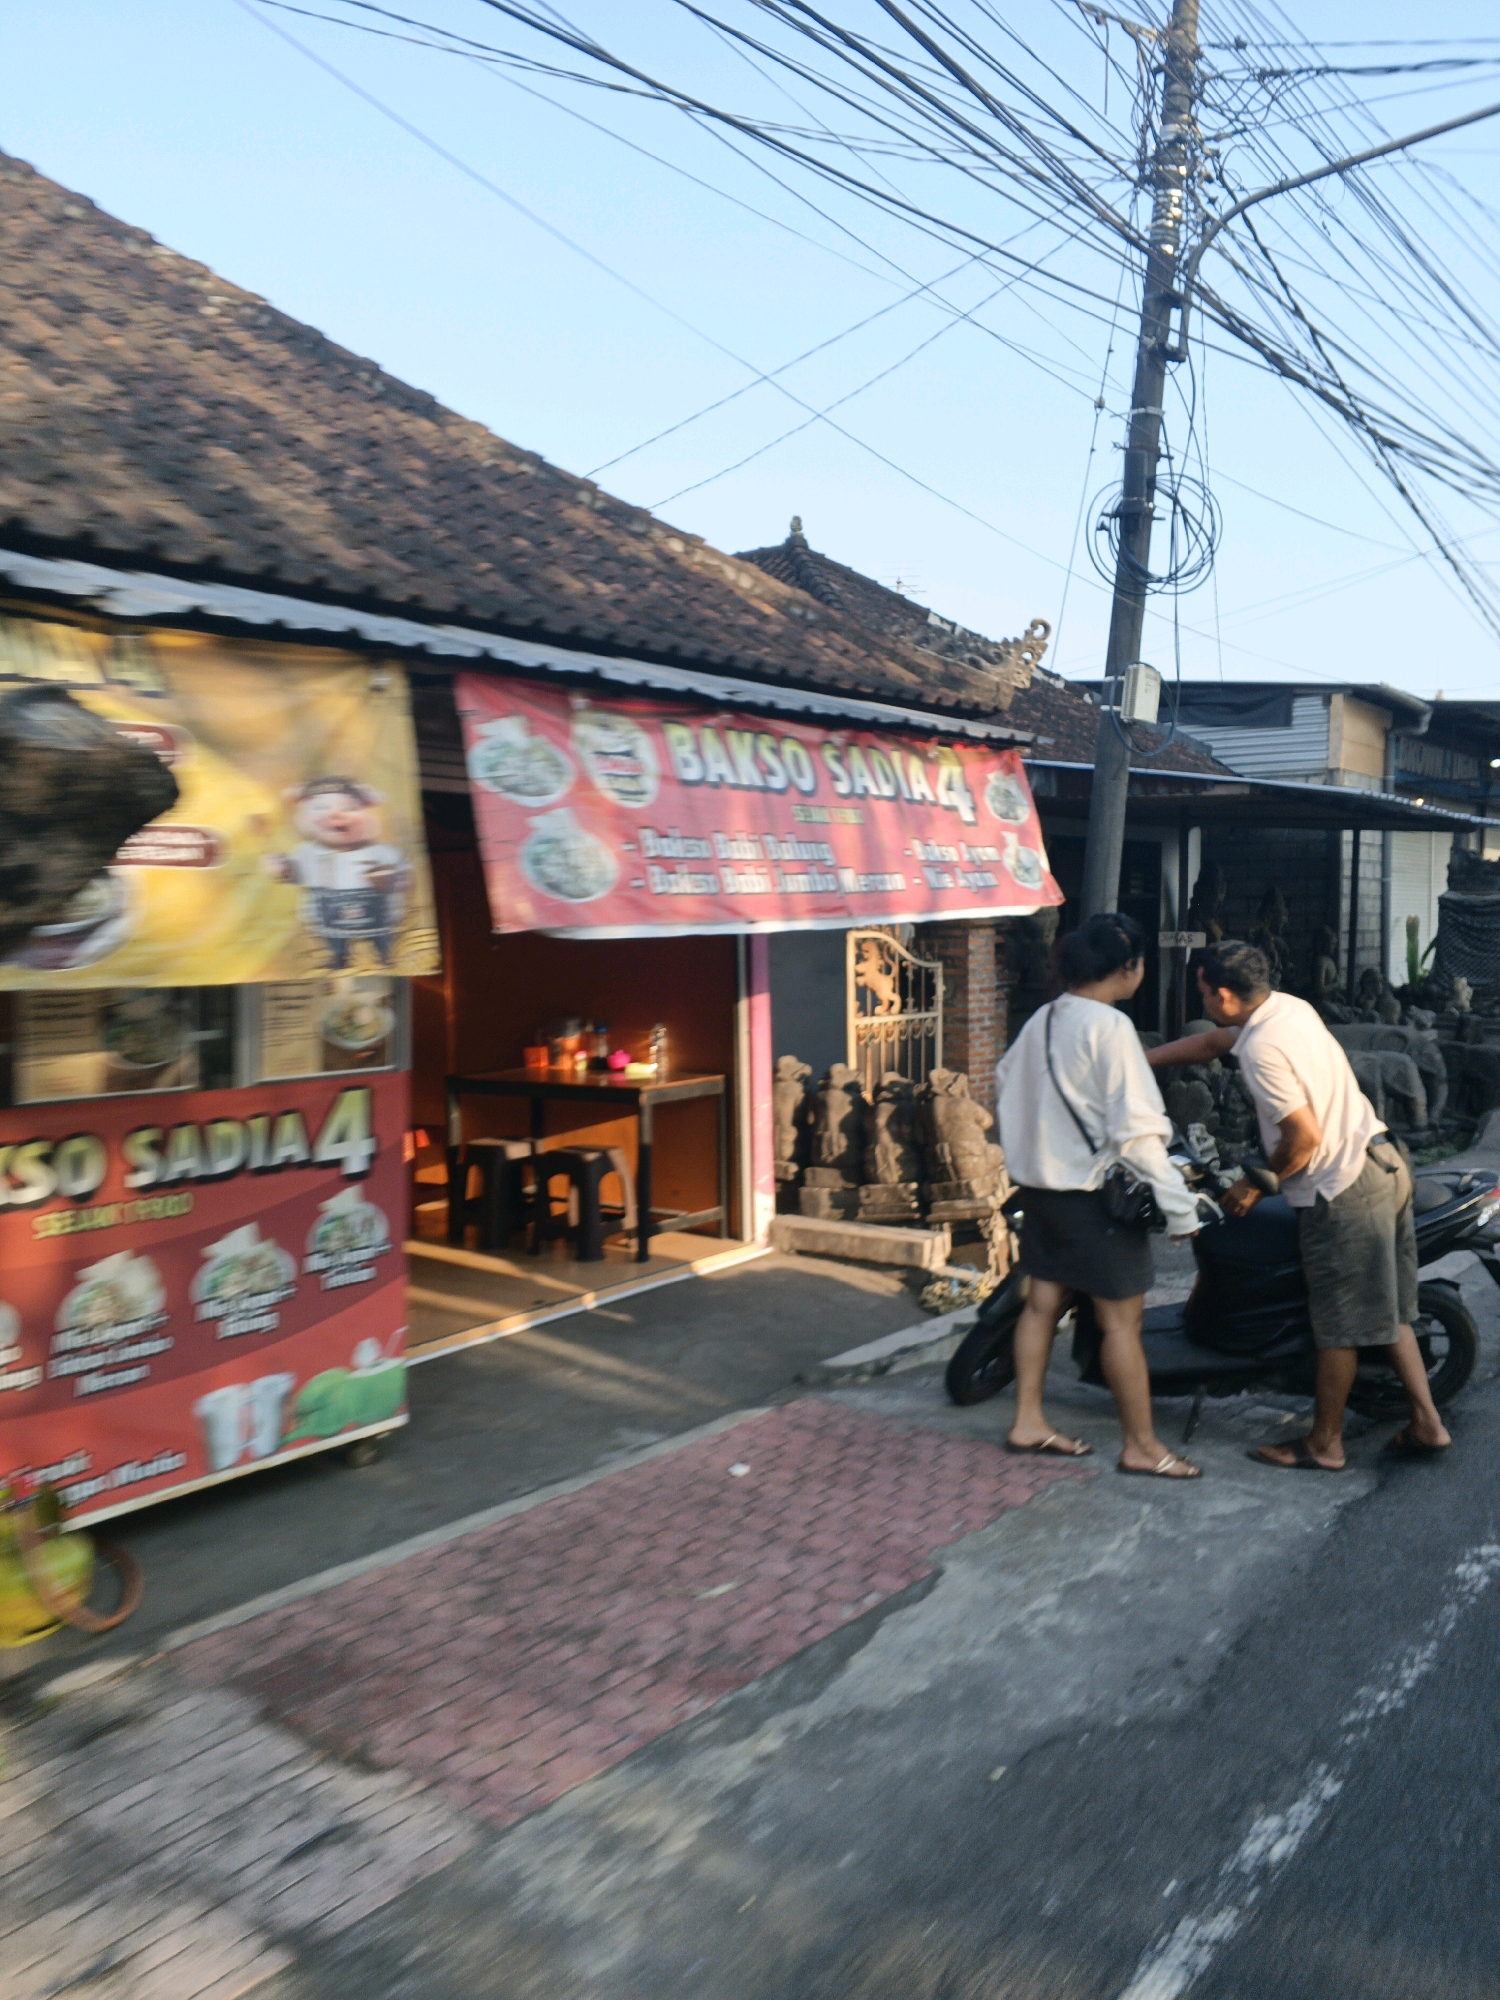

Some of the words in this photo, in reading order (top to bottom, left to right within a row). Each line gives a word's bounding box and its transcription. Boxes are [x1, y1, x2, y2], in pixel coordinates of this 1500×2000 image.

[662, 721, 815, 796] BAKSO
[820, 740, 937, 805] SADIA
[936, 745, 977, 826] 4
[123, 1109, 312, 1192] SADIA
[311, 1086, 377, 1181] 4
